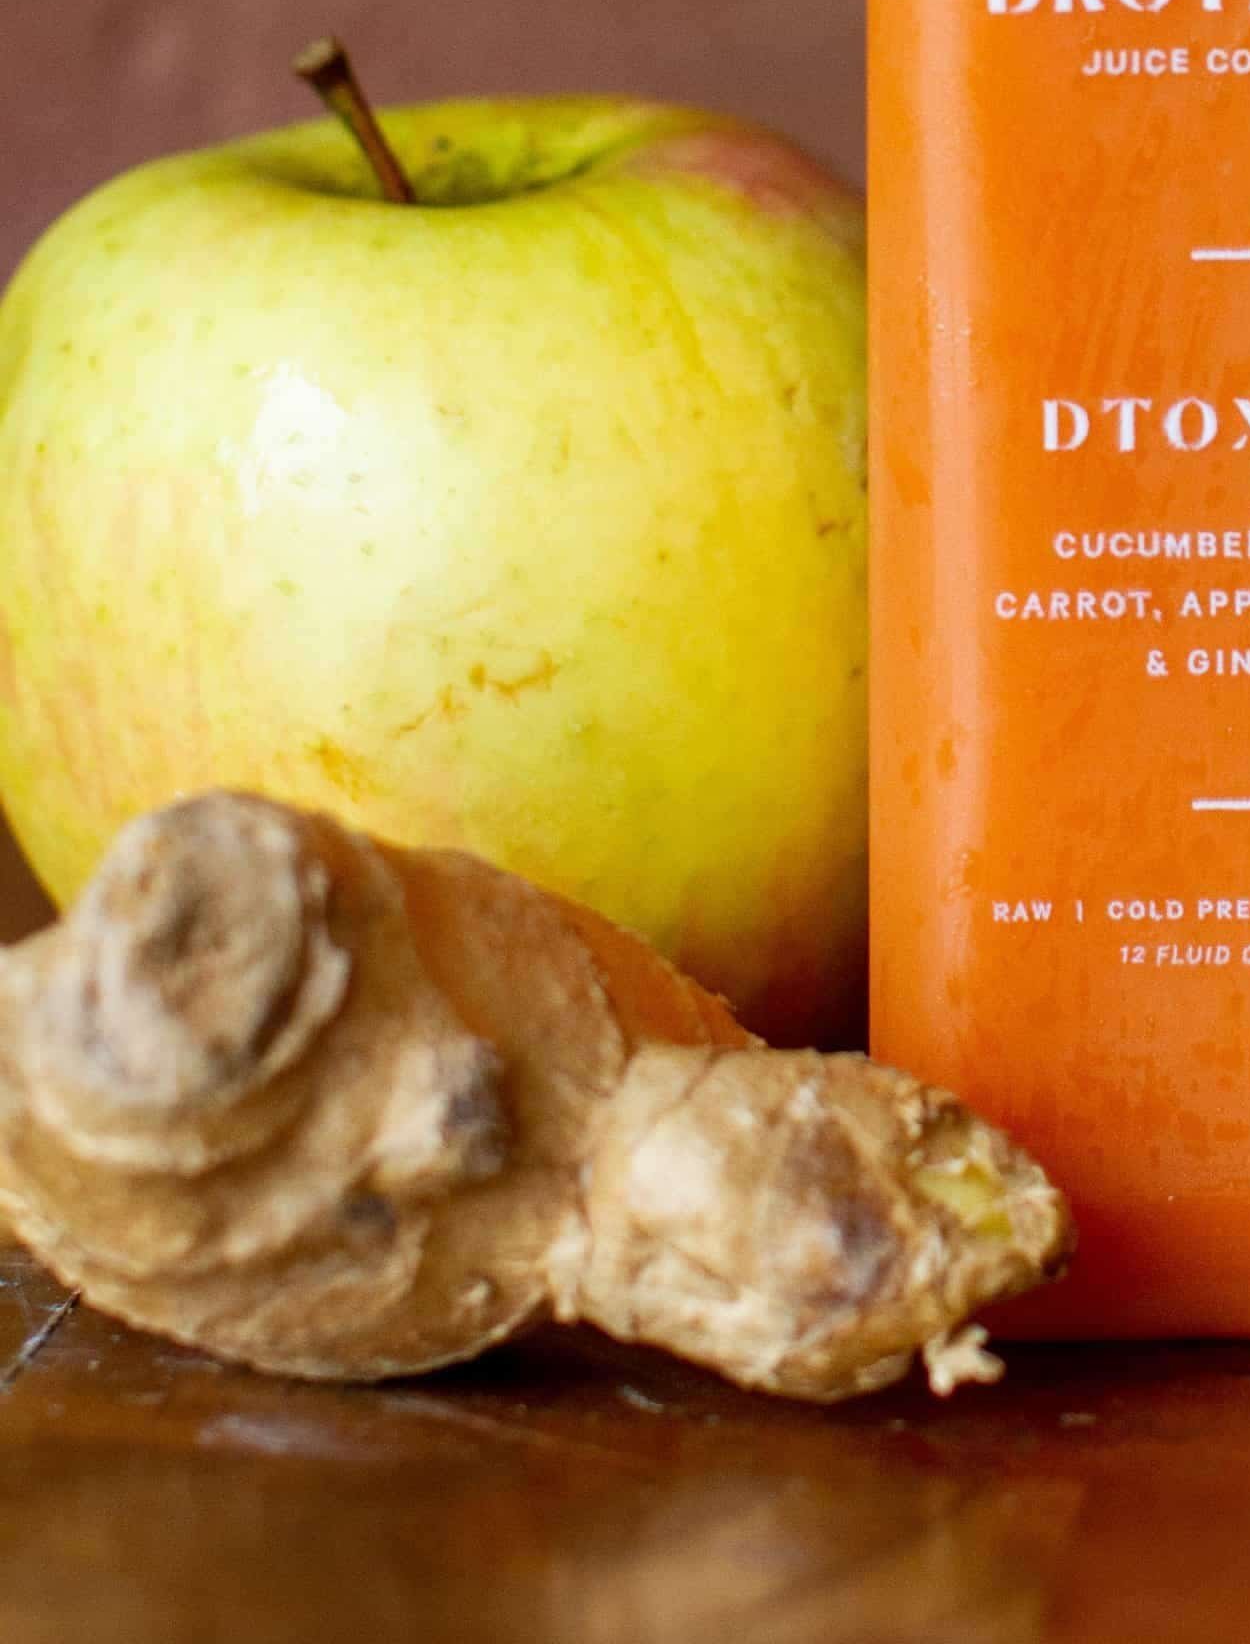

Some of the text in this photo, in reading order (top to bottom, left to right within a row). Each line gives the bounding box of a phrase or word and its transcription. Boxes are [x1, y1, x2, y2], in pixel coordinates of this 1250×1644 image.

[1081, 47, 1190, 77] JUICE
[995, 589, 1162, 621] CARROT,
[1145, 648, 1169, 678] &
[992, 899, 1053, 923] RAW
[1106, 899, 1185, 922] COLD
[1119, 944, 1147, 965] 12
[1155, 943, 1231, 967] FLUID
